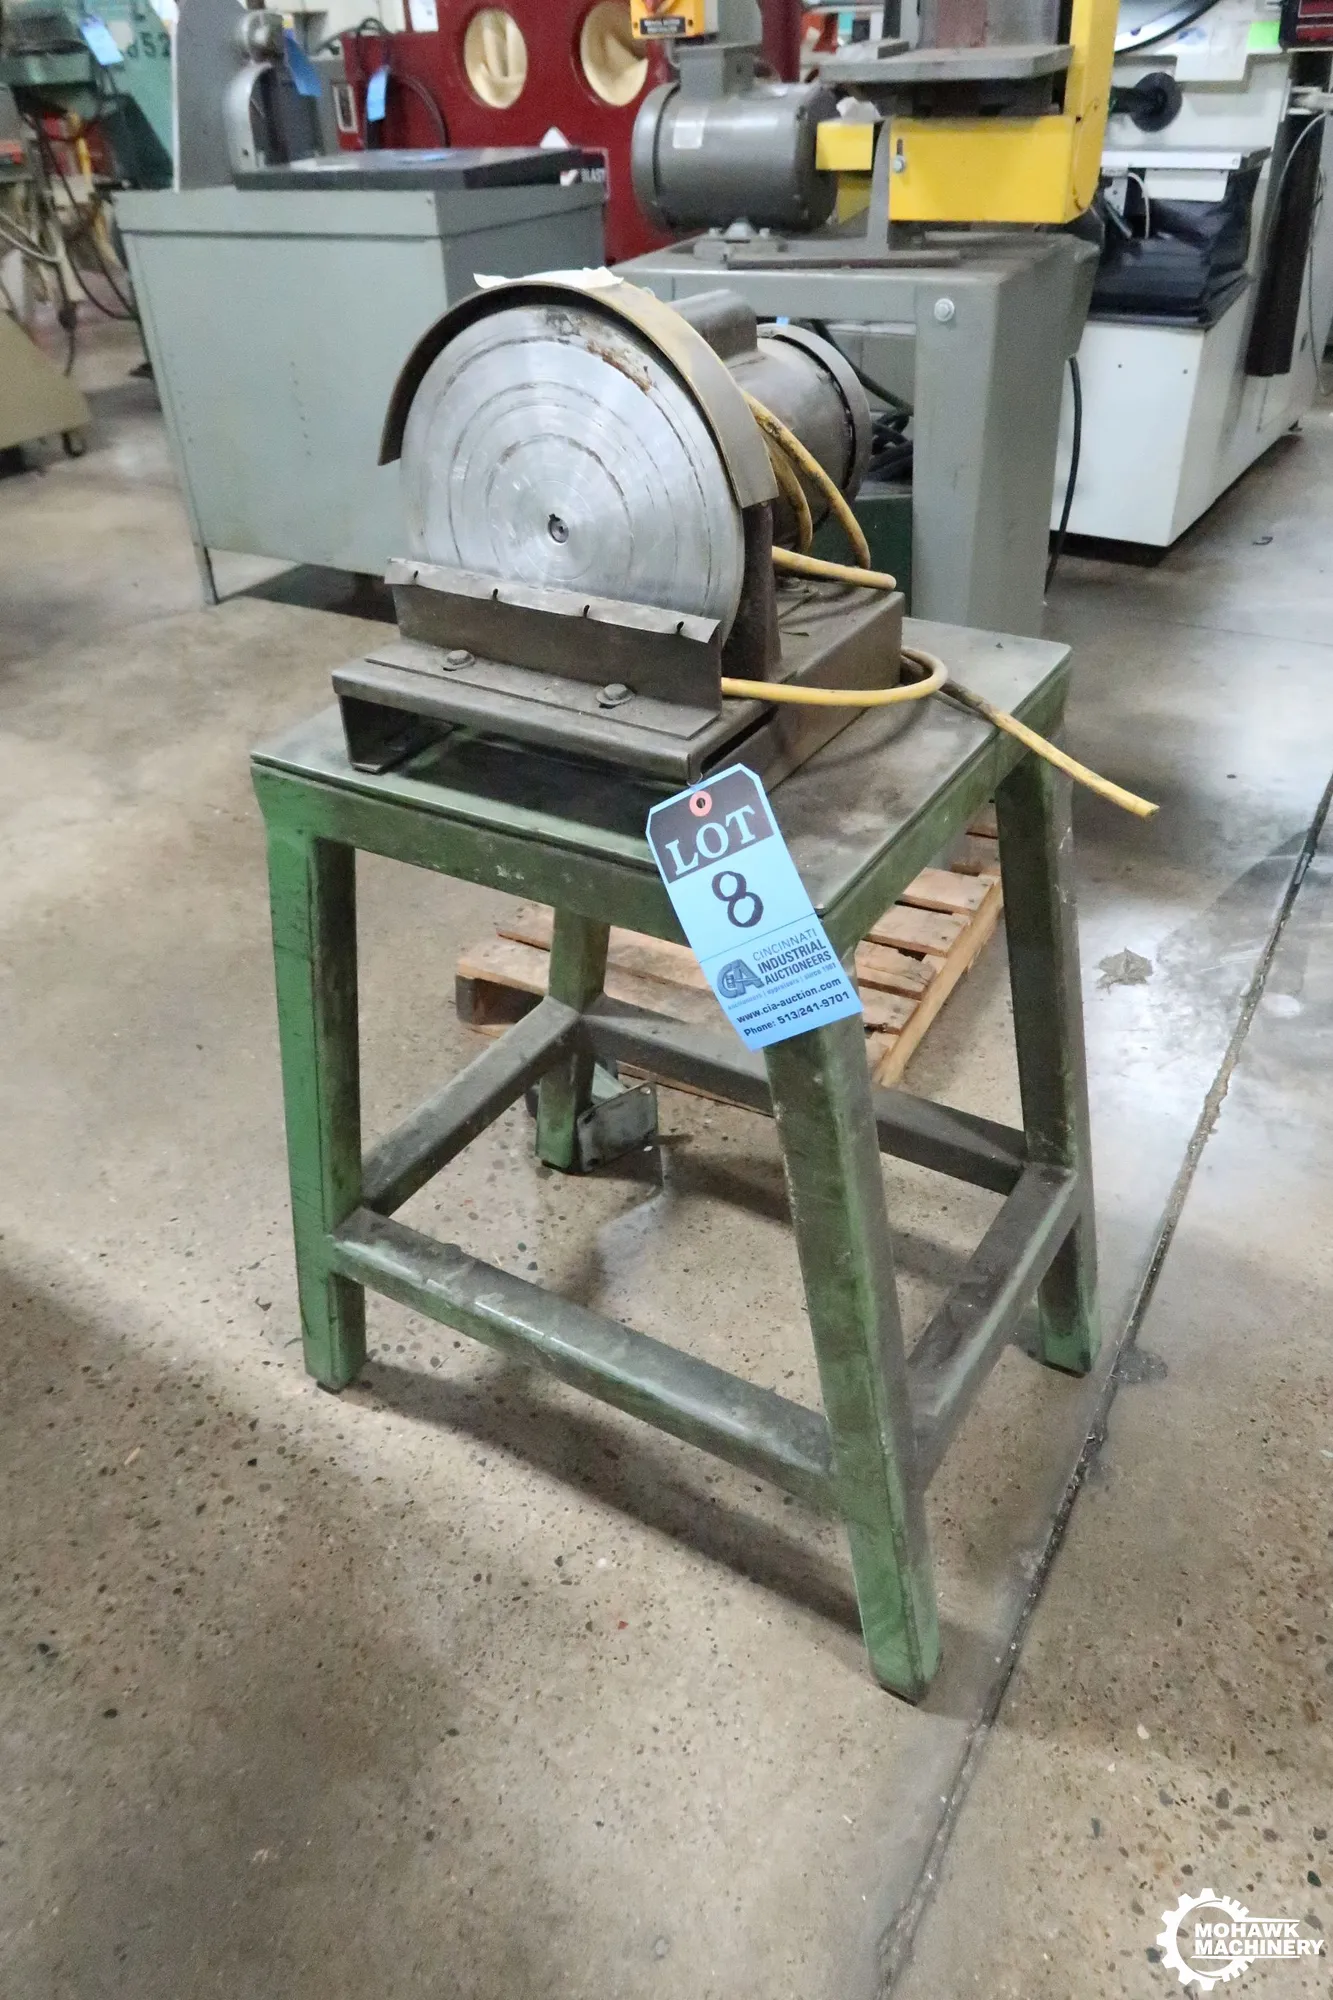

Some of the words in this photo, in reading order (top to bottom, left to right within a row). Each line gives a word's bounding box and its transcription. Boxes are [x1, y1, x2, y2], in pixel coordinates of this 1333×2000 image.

[665, 805, 755, 876] LOT
[711, 870, 764, 928] 8
[752, 928, 818, 961] CINCINNATI
[757, 938, 827, 974] INDUSTRIAL
[764, 950, 832, 986] AUCTIONEERS
[736, 978, 842, 1024] www.cia-auction.com
[743, 1020, 777, 1037] Phone:
[777, 991, 850, 1025] 513/241-9701
